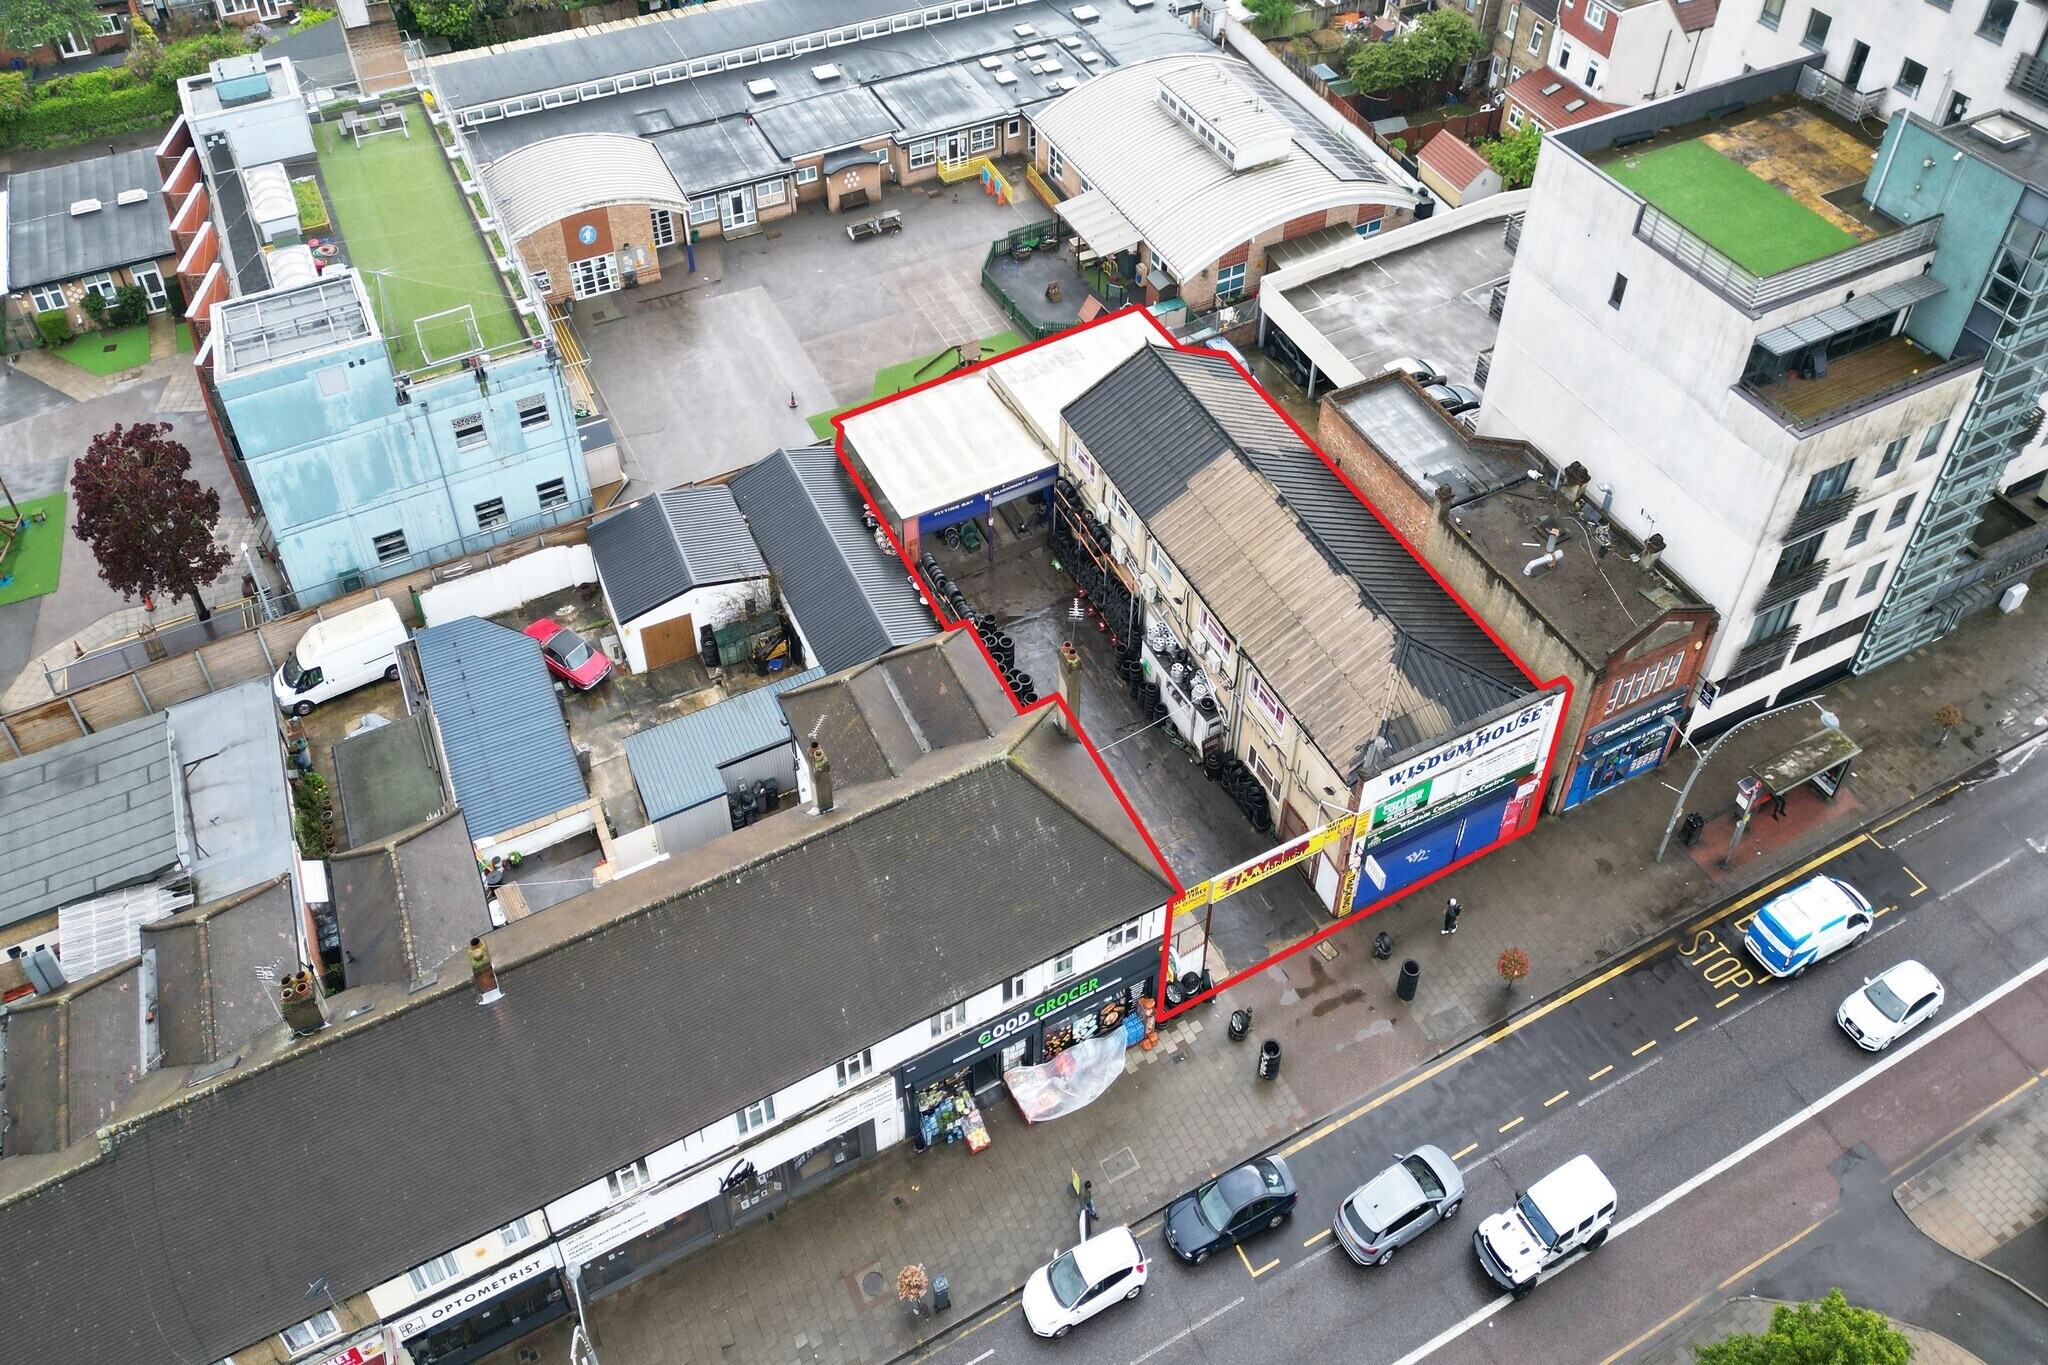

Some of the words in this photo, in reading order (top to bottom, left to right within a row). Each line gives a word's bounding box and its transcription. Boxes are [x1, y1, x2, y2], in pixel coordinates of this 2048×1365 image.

[933, 504, 960, 517] FITTING
[961, 499, 974, 507] BAY
[992, 480, 1026, 496] ALIGNMENT
[1027, 475, 1039, 483] BAY
[1389, 739, 1473, 787] WISDOM
[1475, 708, 1545, 748] HOUSE
[1604, 718, 1636, 738] Romford
[1432, 789, 1478, 814] Community
[1480, 777, 1506, 791] Centre
[1678, 930, 1754, 989] STOP
[978, 1011, 1030, 1045] GOOD
[1033, 977, 1099, 1018] GROCER
[432, 1260, 541, 1319] OPTOMETRIST
